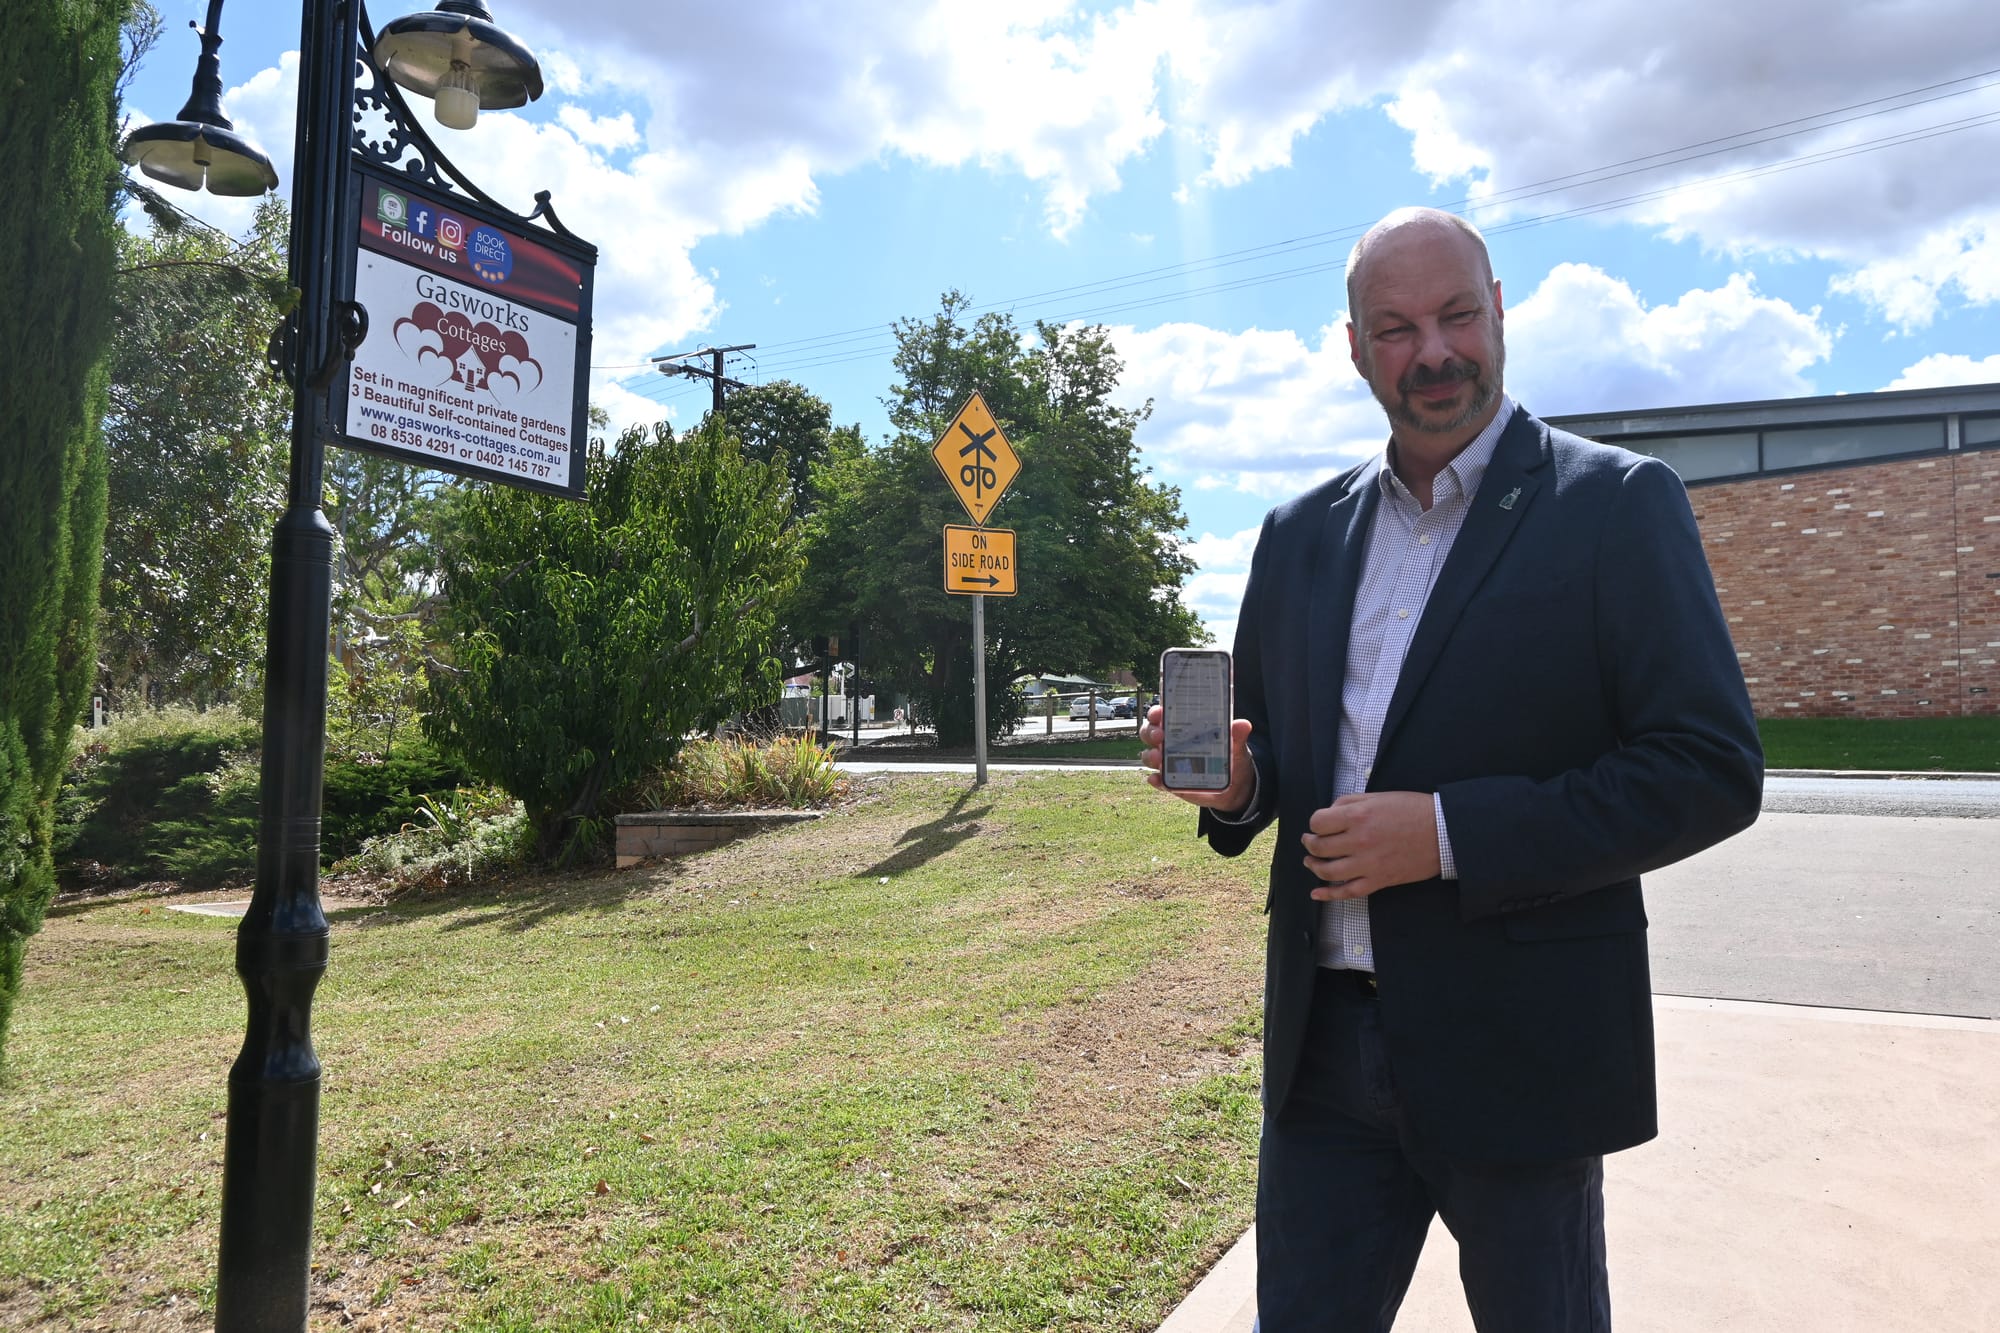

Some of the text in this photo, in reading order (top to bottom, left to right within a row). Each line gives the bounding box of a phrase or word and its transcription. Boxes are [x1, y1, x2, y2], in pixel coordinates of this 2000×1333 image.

[381, 222, 457, 264] Follow us
[474, 242, 506, 262] DIRECT
[477, 232, 504, 250] BOOK
[416, 274, 529, 332] Gasworks
[437, 318, 506, 354] Cottages
[352, 384, 568, 452] 3 Beautiful Self-contained Cottages
[354, 366, 566, 436] Set in magnificent private gardens
[360, 406, 561, 465] www.gasworks-cottages.com.au
[371, 424, 550, 478] 08 8536 4291 or 0402 145 787
[952, 552, 1009, 570] SIDE ROAD
[972, 535, 987, 550] ON
